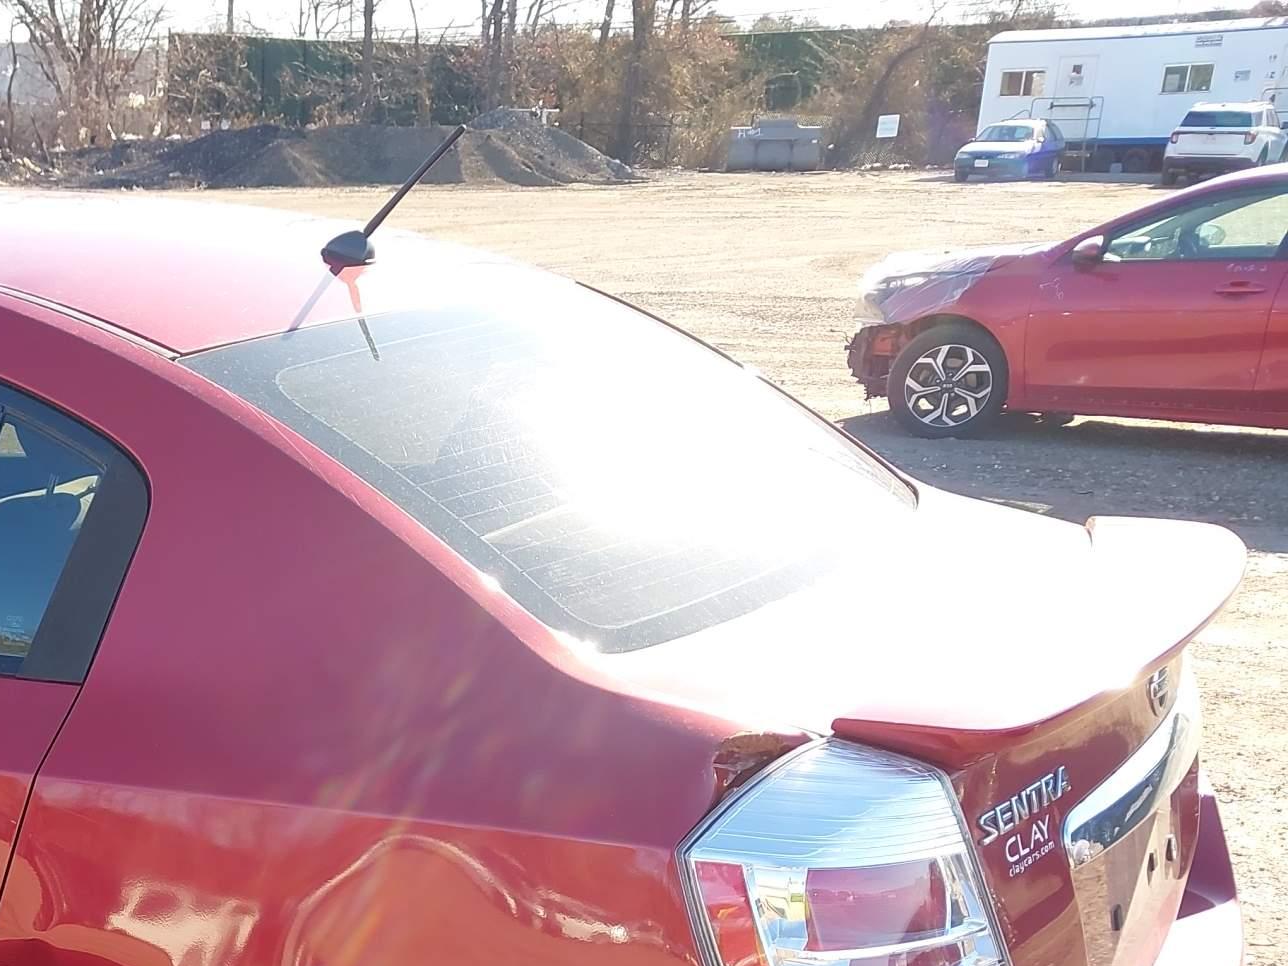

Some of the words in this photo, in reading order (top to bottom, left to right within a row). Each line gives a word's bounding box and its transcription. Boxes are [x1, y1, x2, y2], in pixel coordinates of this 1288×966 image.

[978, 765, 1072, 846] SENTRA
[1005, 814, 1050, 863] CLAY
[1009, 840, 1055, 878] claycars.com
